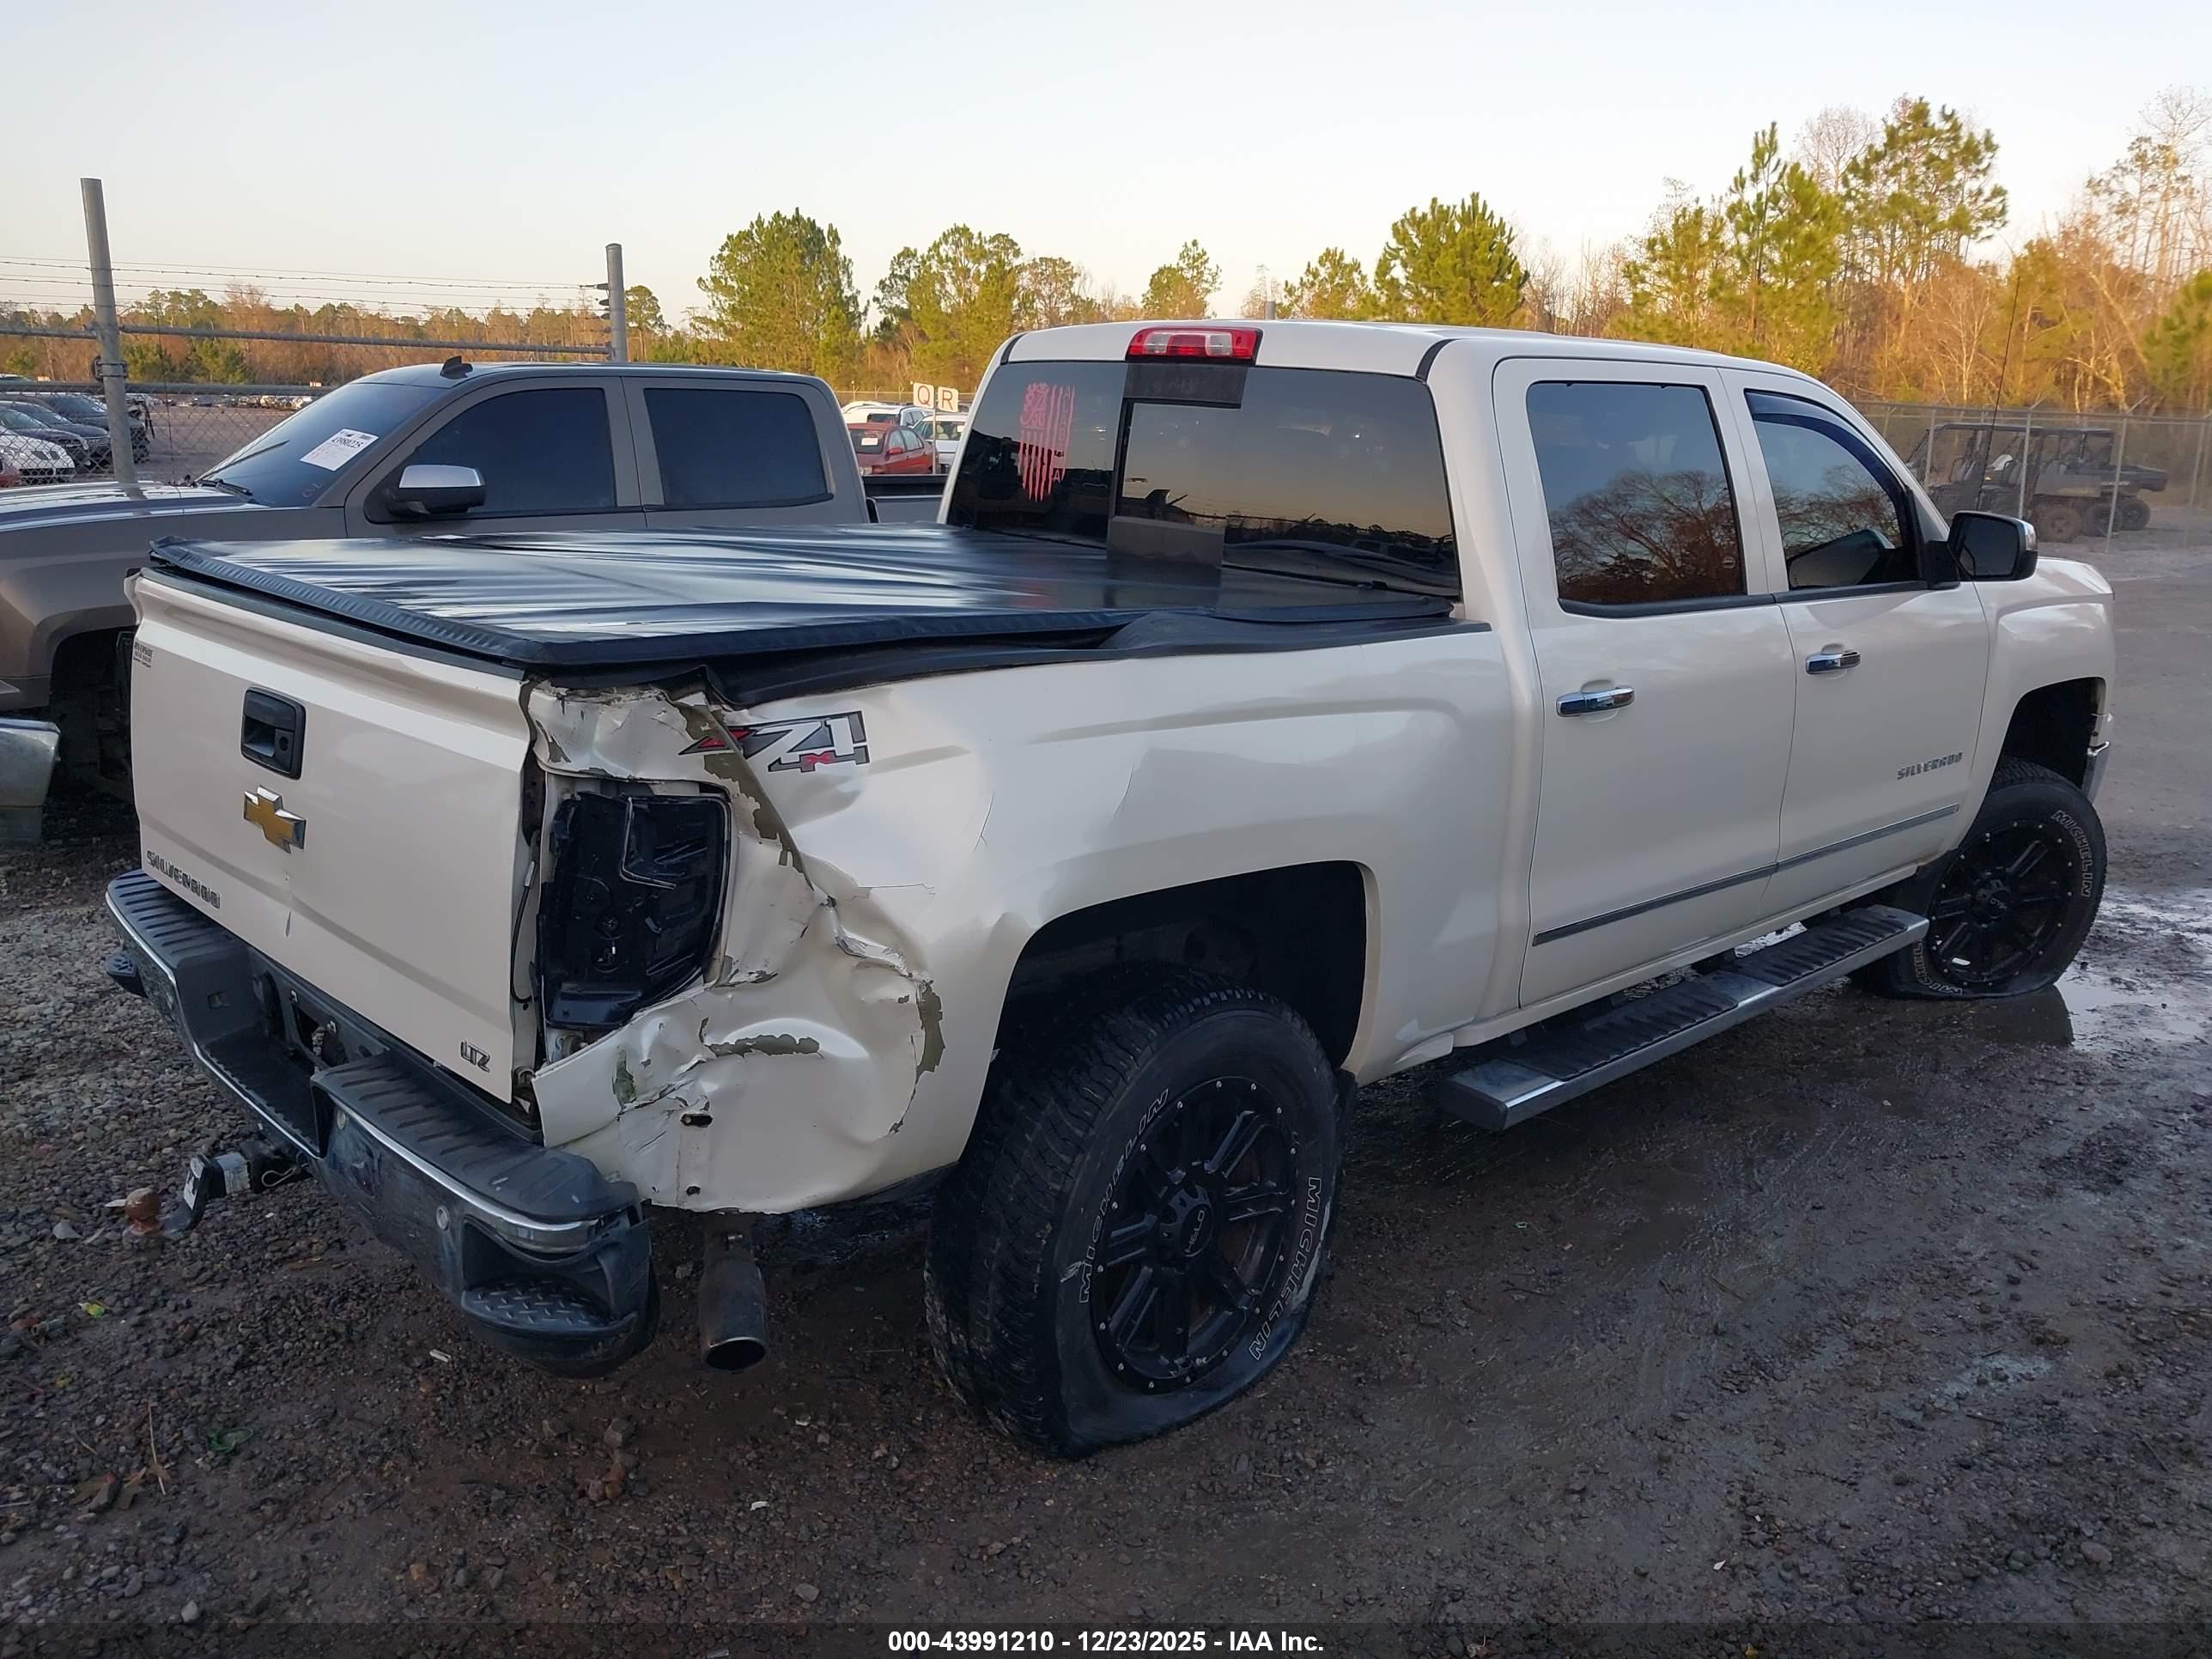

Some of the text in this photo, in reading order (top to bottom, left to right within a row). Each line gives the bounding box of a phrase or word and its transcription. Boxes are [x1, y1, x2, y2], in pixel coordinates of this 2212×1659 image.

[917, 385, 931, 407] Q
[942, 389, 954, 410] R
[1896, 751, 1963, 780] SILVERADO
[2051, 810, 2094, 898] MICHELIN
[146, 849, 221, 909] SILVERADO
[460, 1040, 491, 1073] LTZ
[1079, 1088, 1169, 1304] MICHELIN
[1249, 1176, 1322, 1361] MICHELIN
